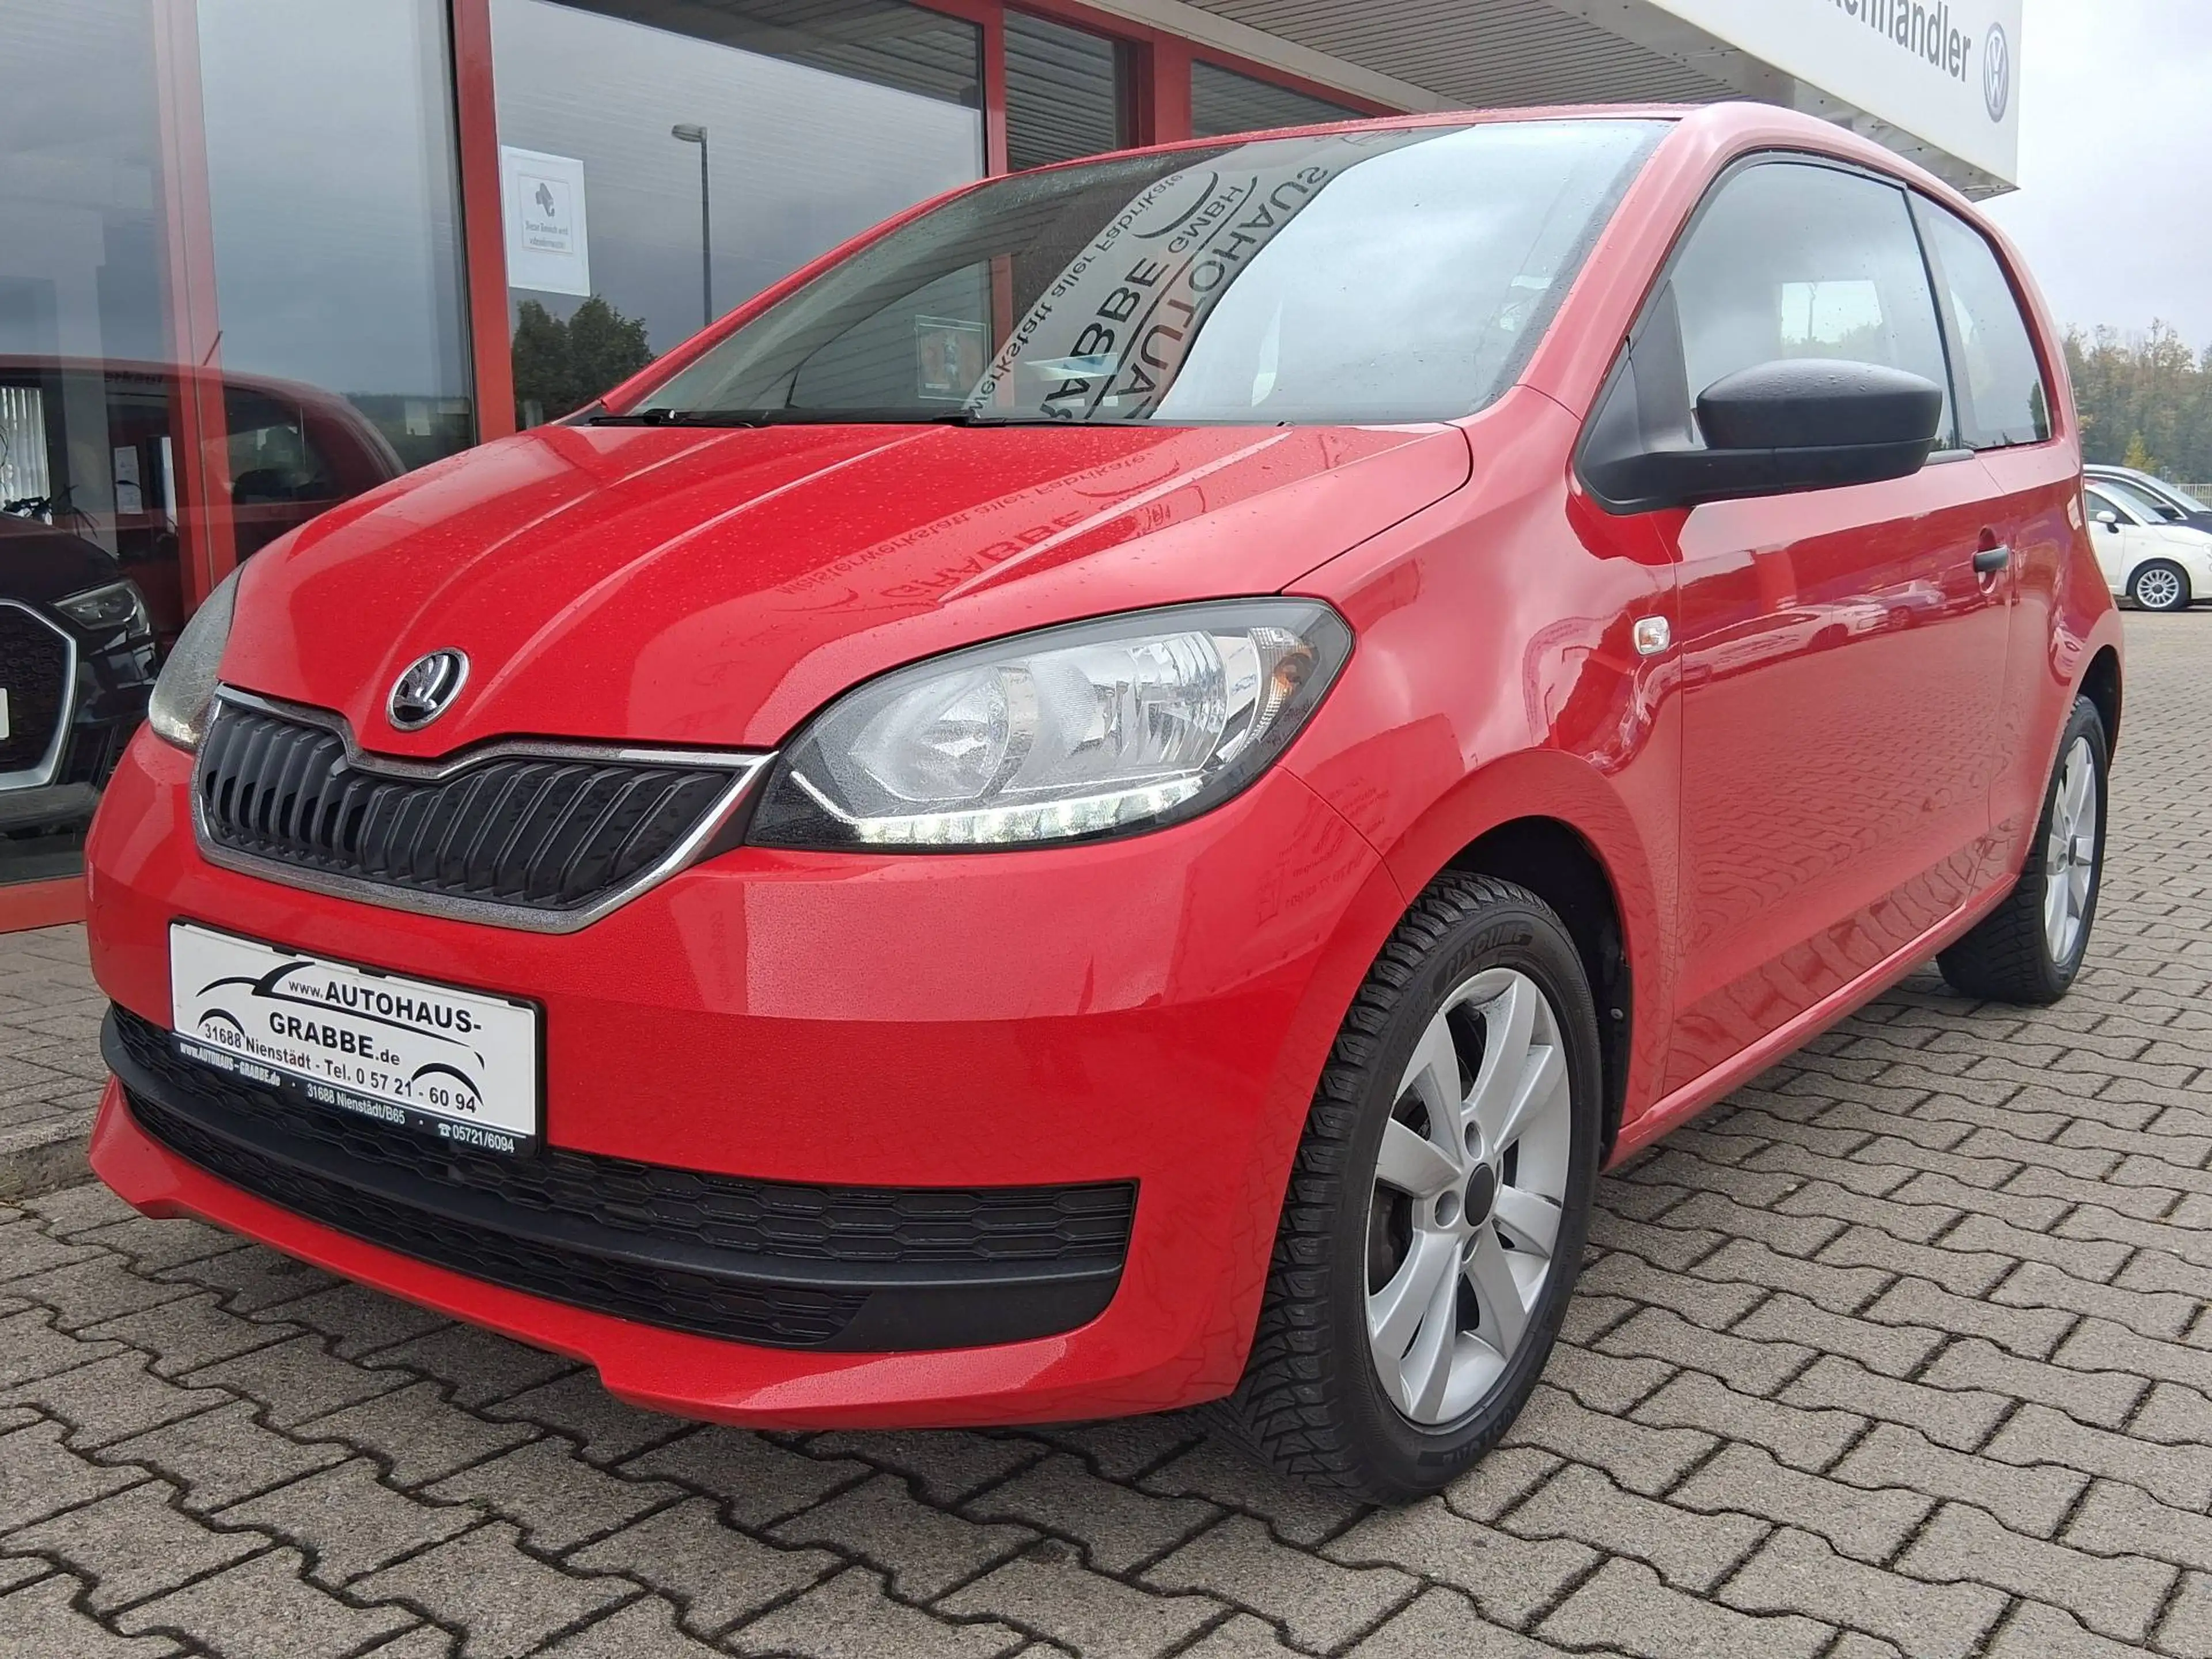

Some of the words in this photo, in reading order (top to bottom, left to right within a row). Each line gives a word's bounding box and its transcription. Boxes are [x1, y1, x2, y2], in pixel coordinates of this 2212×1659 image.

[204, 1023, 241, 1048] 31688
[245, 1036, 311, 1070] Nienstädt
[324, 1059, 351, 1081] Tel.
[356, 1067, 365, 1085] 0
[370, 1073, 388, 1090] 57
[394, 1078, 412, 1097] 21
[429, 1086, 449, 1107] 60
[455, 1093, 477, 1113] 94
[270, 1012, 400, 1066] GRABBE.de
[307, 1084, 335, 1103] 31688
[336, 1092, 406, 1125] Nienstädt/B65
[453, 1125, 515, 1153] 05721/6094
